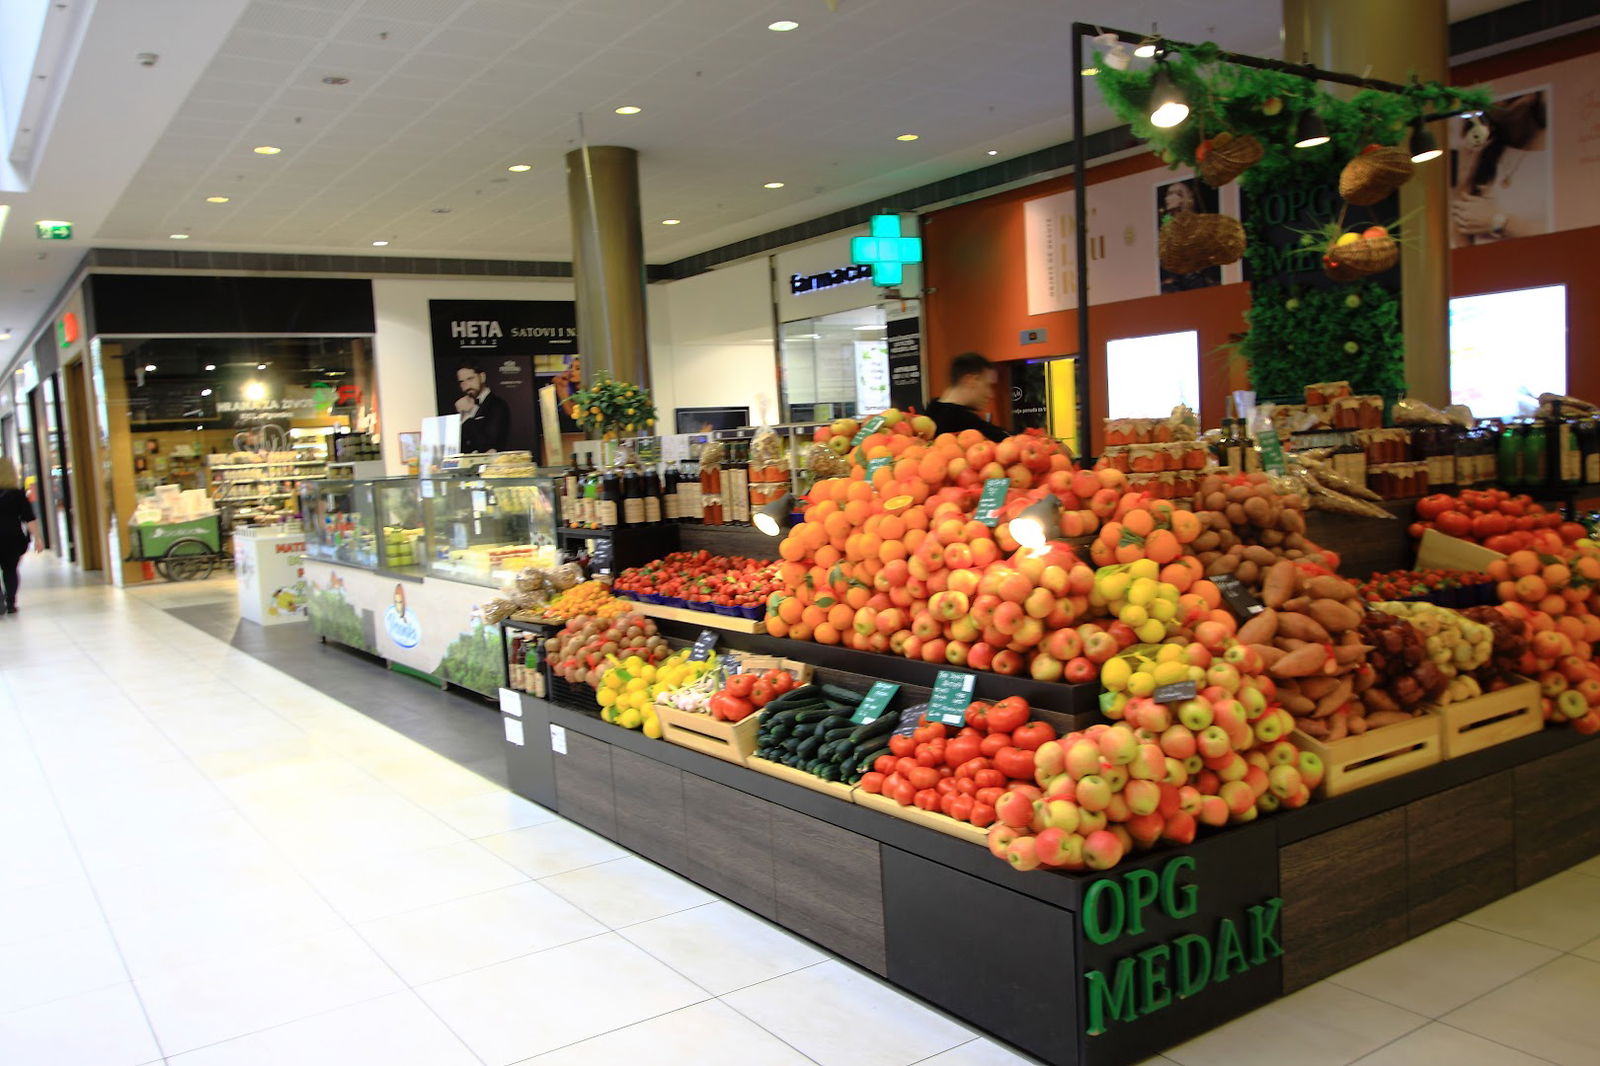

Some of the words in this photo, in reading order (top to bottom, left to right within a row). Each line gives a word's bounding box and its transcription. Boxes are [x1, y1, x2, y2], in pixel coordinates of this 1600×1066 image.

[451, 320, 503, 338] HETA
[511, 327, 556, 337] SATOVI
[1083, 856, 1199, 945] OPG
[1084, 897, 1285, 1037] MEDAK
